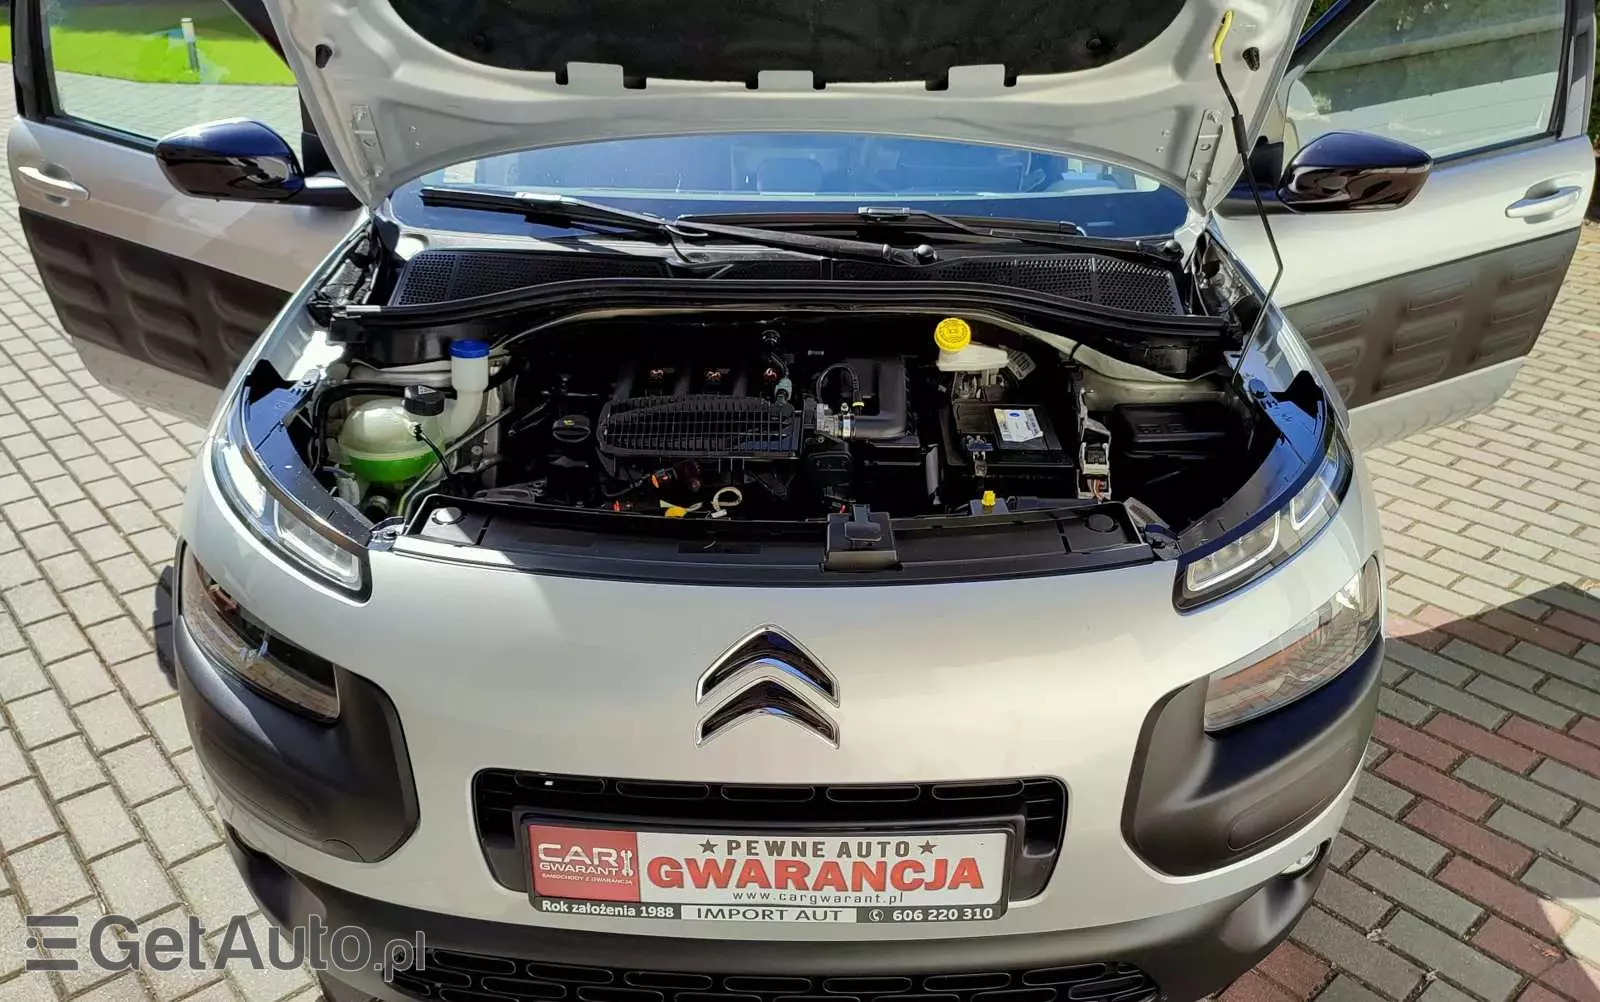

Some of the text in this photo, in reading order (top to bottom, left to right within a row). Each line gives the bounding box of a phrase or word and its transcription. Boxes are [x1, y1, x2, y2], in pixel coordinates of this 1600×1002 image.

[538, 843, 619, 867] CAR
[727, 839, 911, 858] PEWNE AUTO
[540, 862, 619, 876] GWARANT
[647, 856, 984, 893] GWARANCJA
[733, 892, 903, 904] www.cargwarant.pl
[542, 900, 674, 918] Rok założenia 1988
[697, 908, 843, 921] IMPORT AUT
[892, 907, 993, 921] 606 220 310
